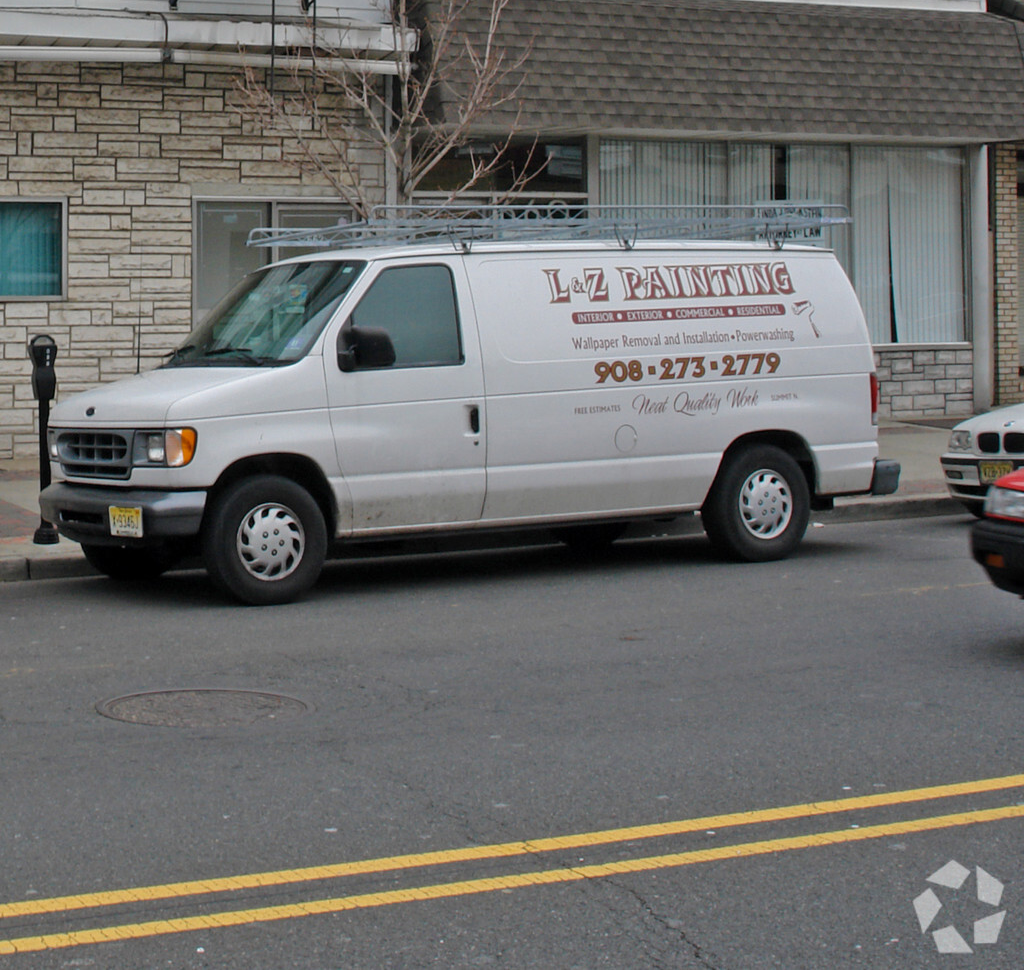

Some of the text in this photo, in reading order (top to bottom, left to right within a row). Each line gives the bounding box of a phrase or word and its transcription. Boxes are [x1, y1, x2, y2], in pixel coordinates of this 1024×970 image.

[542, 261, 796, 304] L&Z PAINTING
[577, 305, 781, 322] INTERIOR EXTERIOR COMMERCIAL RESIDENTIAL
[572, 328, 795, 352] Wallpaper Removal and Installation Powerwashing
[574, 404, 621, 415] FREE ESTIMATES
[631, 386, 760, 417] Neat Quality Work
